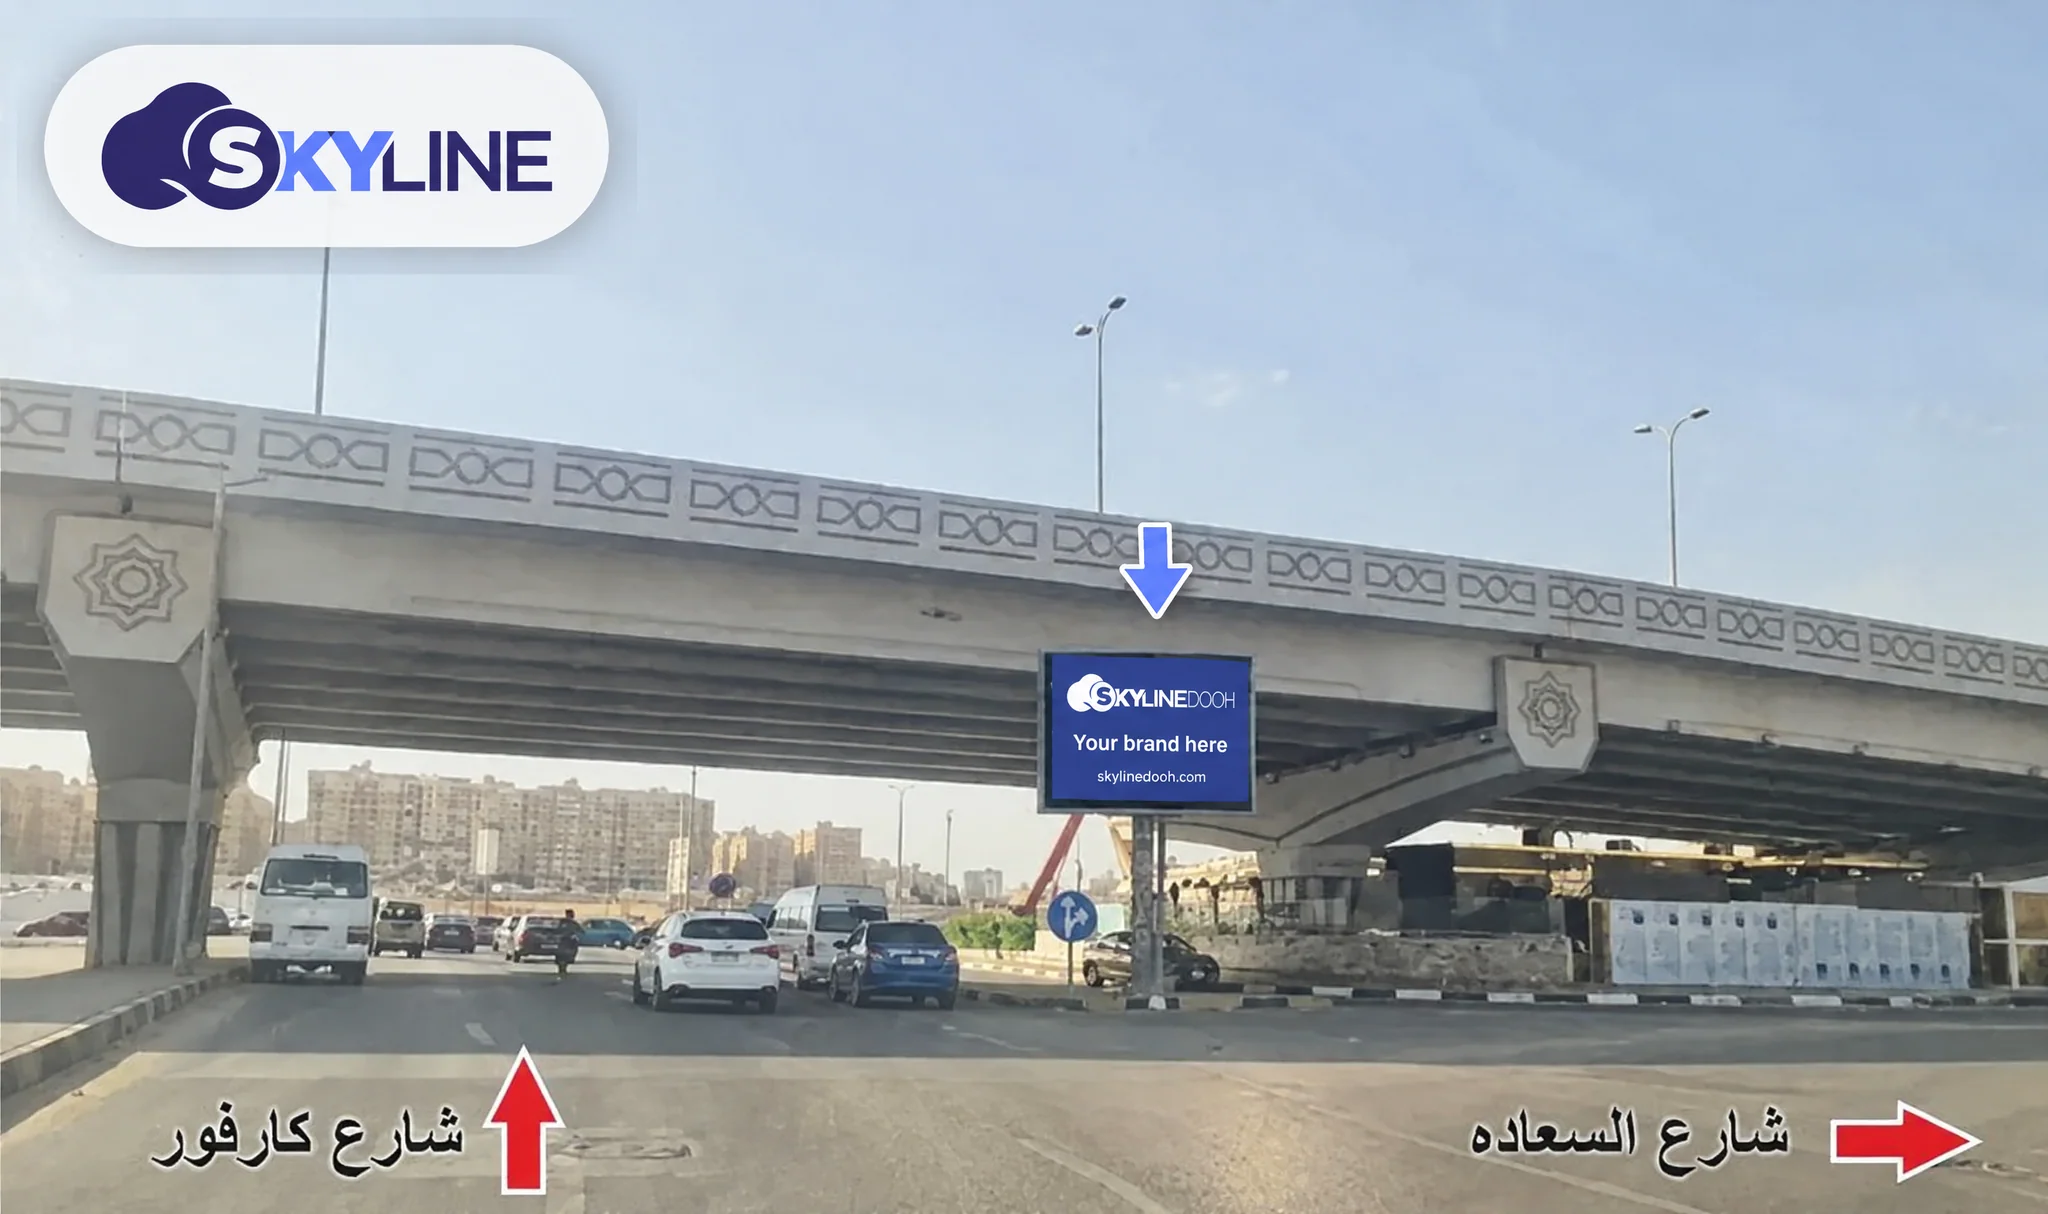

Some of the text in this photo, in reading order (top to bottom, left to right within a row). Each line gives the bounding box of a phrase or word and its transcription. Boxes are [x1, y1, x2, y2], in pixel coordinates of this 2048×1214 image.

[1073, 734, 1228, 753] Your brand here
[1097, 770, 1206, 785] skylinedooh.com
